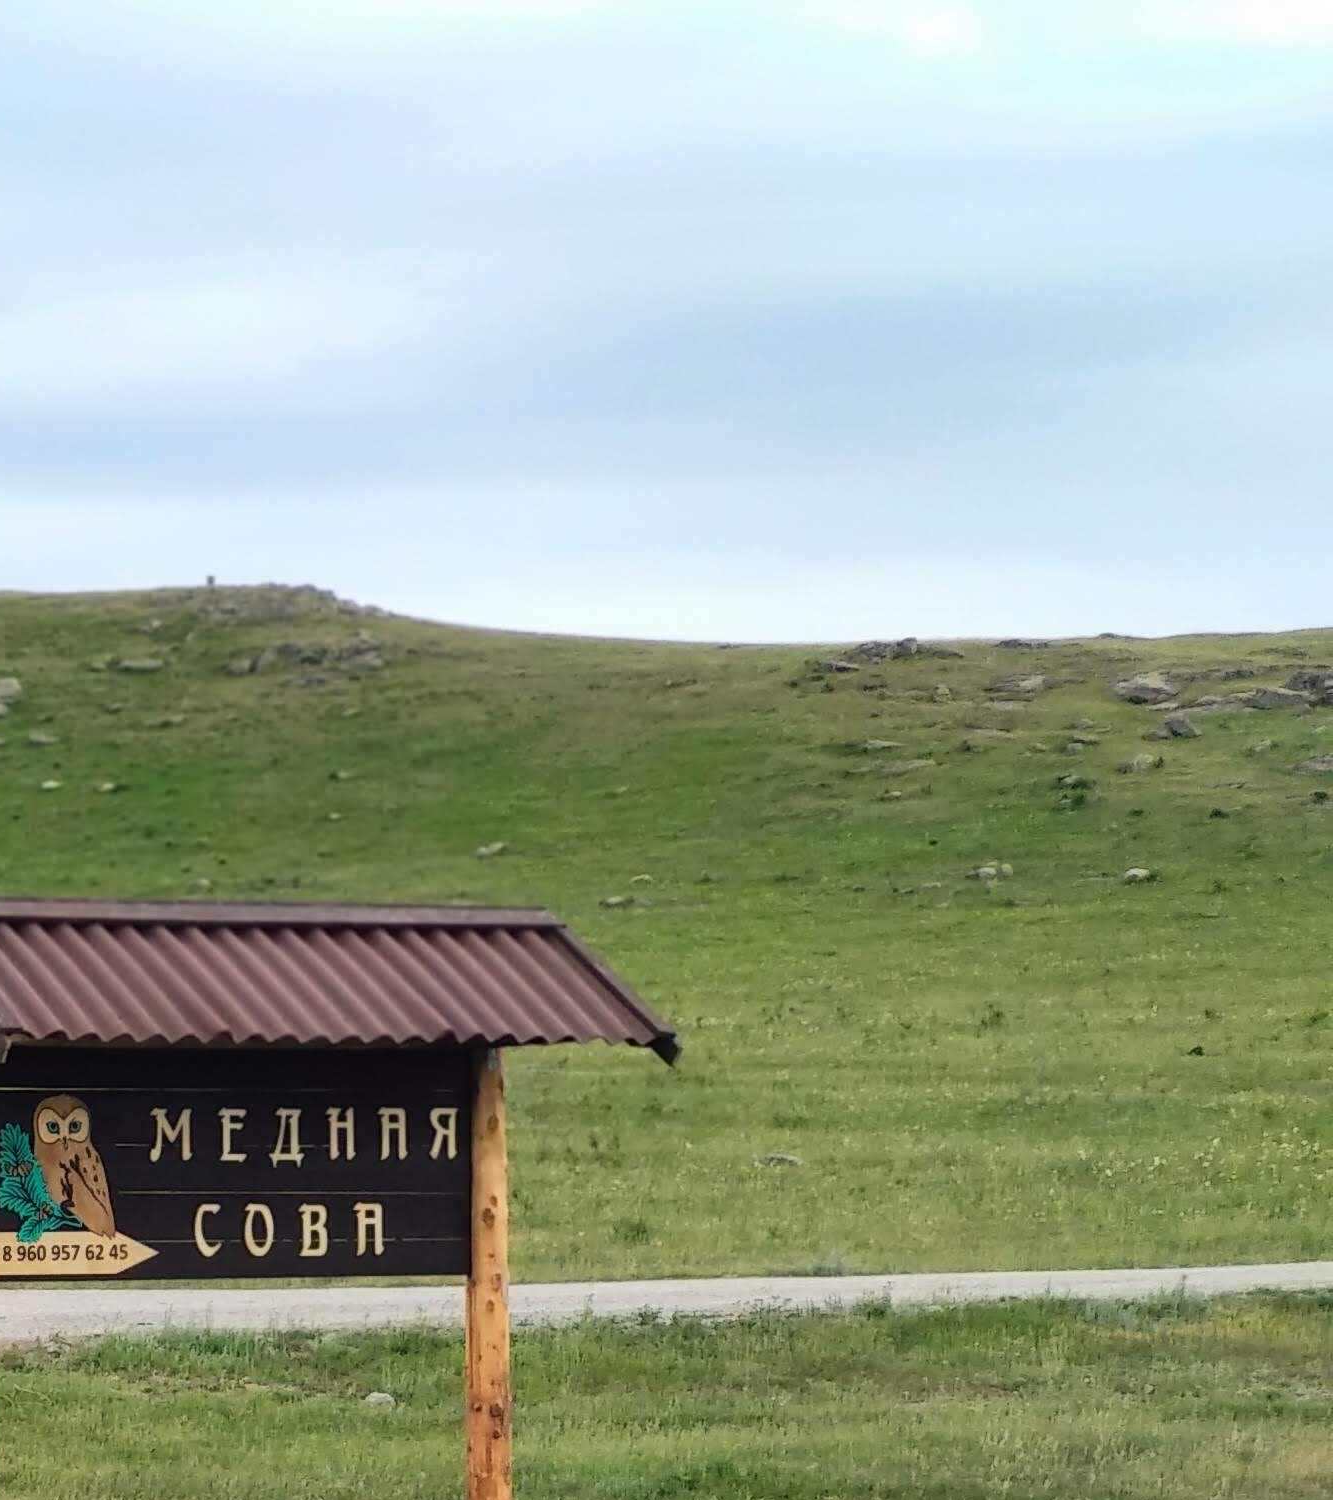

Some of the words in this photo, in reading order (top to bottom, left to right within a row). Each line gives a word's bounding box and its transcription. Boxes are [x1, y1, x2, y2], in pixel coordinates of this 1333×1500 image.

[149, 1107, 458, 1167] МЕДНАЯ
[2, 1246, 12, 1262] 8
[16, 1245, 47, 1262] 960
[51, 1245, 81, 1261] 957
[85, 1244, 105, 1260] 62
[108, 1243, 129, 1260] 45
[194, 1203, 386, 1258] СОВА
